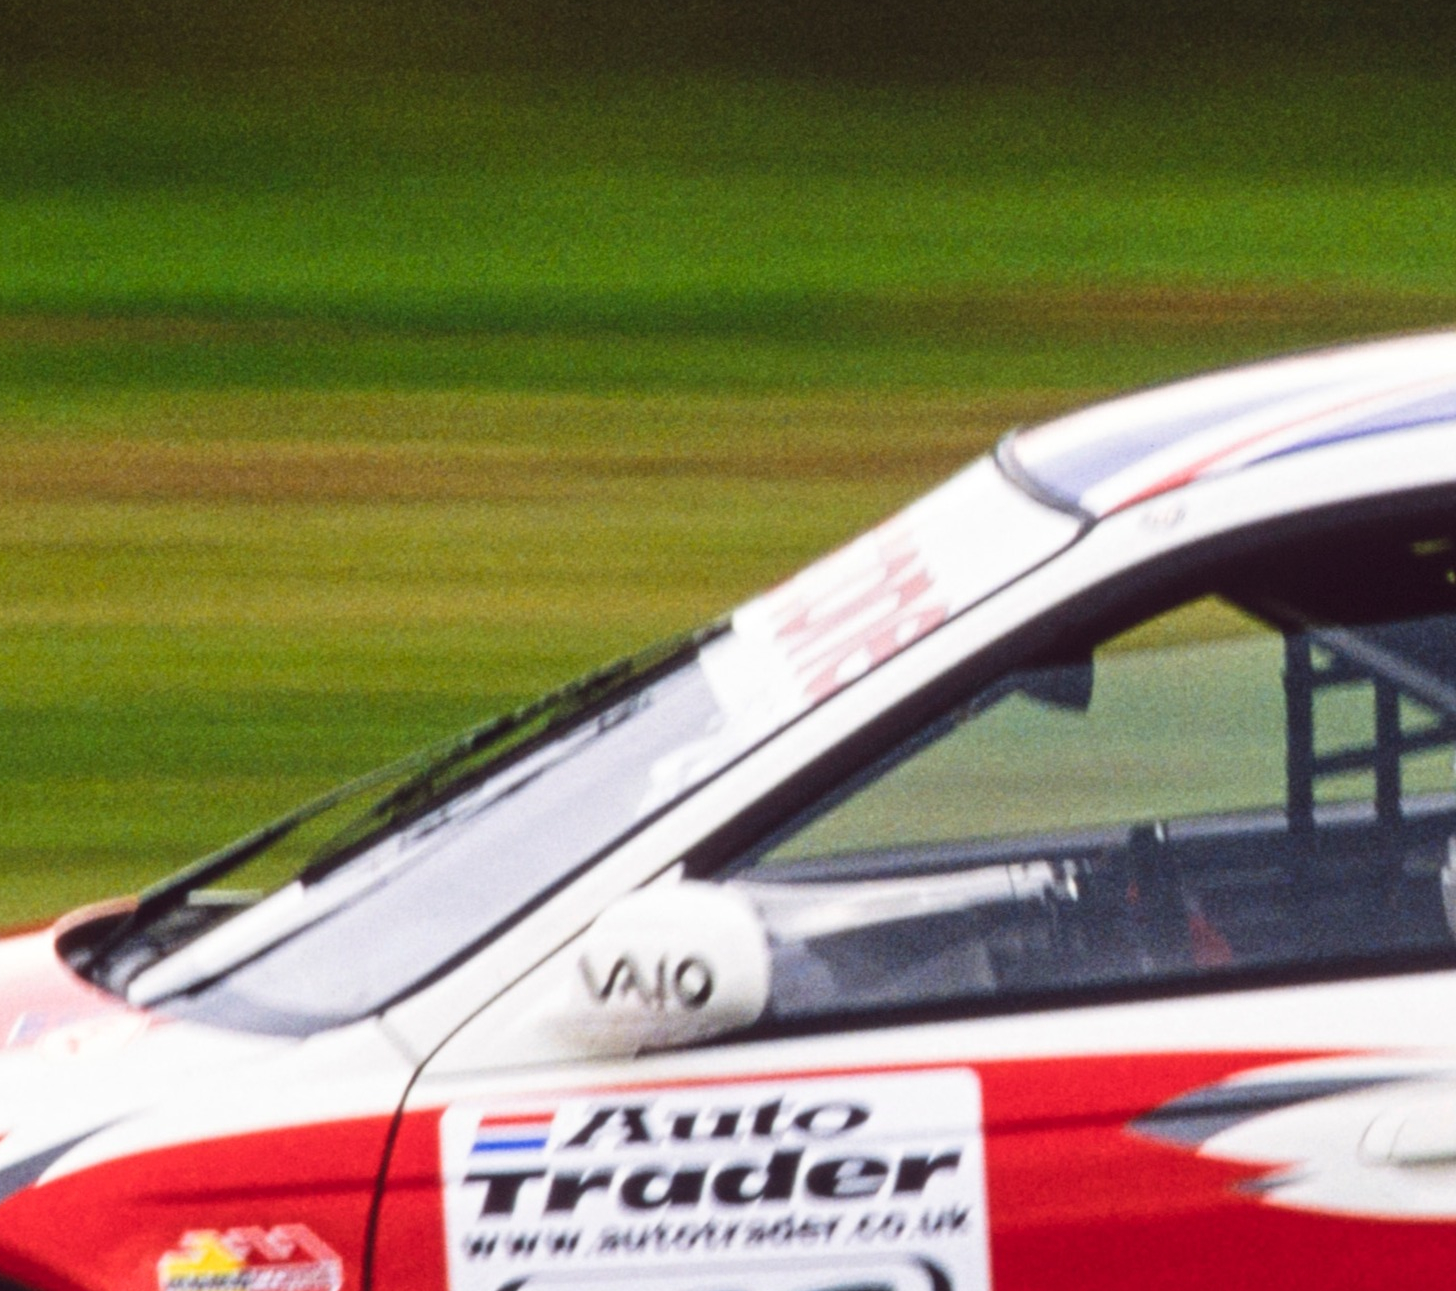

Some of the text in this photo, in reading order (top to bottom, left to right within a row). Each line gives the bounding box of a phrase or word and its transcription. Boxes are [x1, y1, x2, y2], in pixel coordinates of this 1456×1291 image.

[578, 952, 715, 1010] VAIO
[558, 1092, 872, 1150] Auto
[463, 1148, 966, 1218] Trader
[465, 1206, 971, 1261] www.autotrader.co.uk
